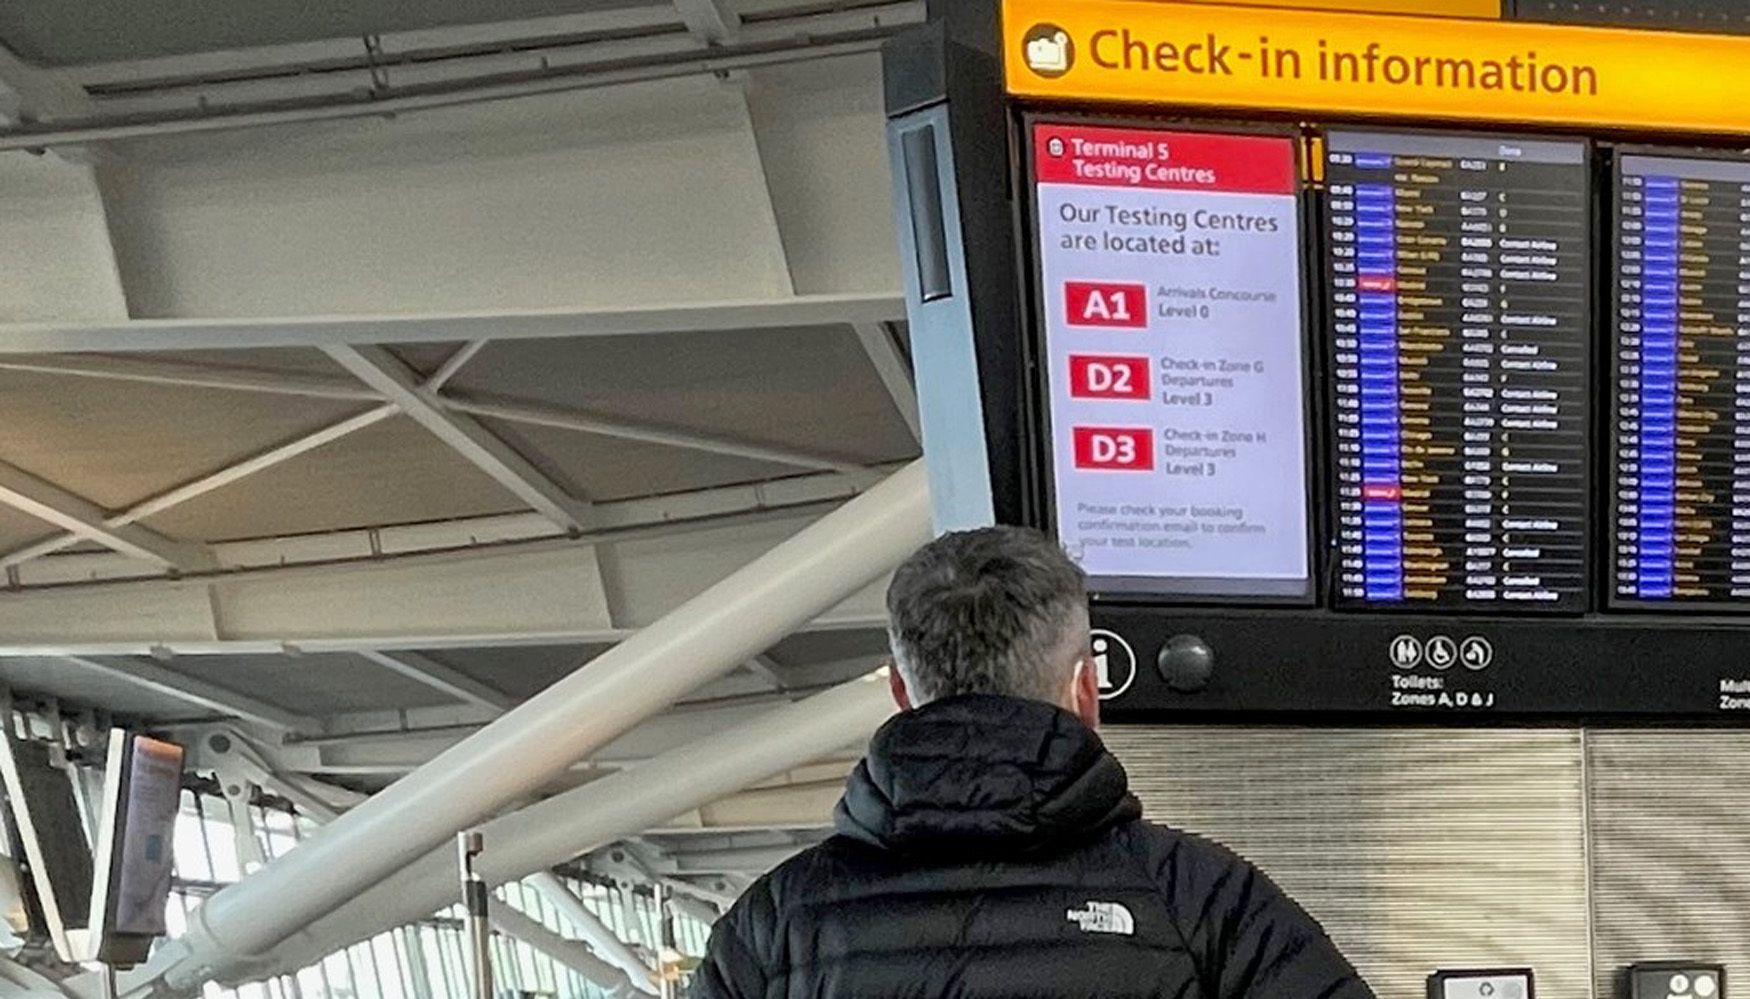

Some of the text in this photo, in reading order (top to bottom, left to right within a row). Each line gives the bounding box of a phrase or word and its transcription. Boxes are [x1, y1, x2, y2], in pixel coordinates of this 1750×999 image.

[1090, 29, 1598, 96] Check-in information
[1071, 138, 1170, 159] Terminal 5
[1073, 159, 1216, 183] Testing Centres
[1060, 203, 1278, 232] Our Testing Centres
[1060, 232, 1220, 256] are located at:
[1083, 290, 1130, 320] A1
[1159, 304, 1209, 318] Level 0
[1087, 363, 1133, 392] D2
[1163, 392, 1213, 406] Level 3
[1092, 435, 1136, 463] D3
[1166, 463, 1216, 476] Level 3
[1392, 675, 1444, 689] Toilets:
[1392, 691, 1436, 705] Zones
[1438, 692, 1453, 708] A,
[1456, 692, 1468, 706] D
[1486, 692, 1494, 707] J
